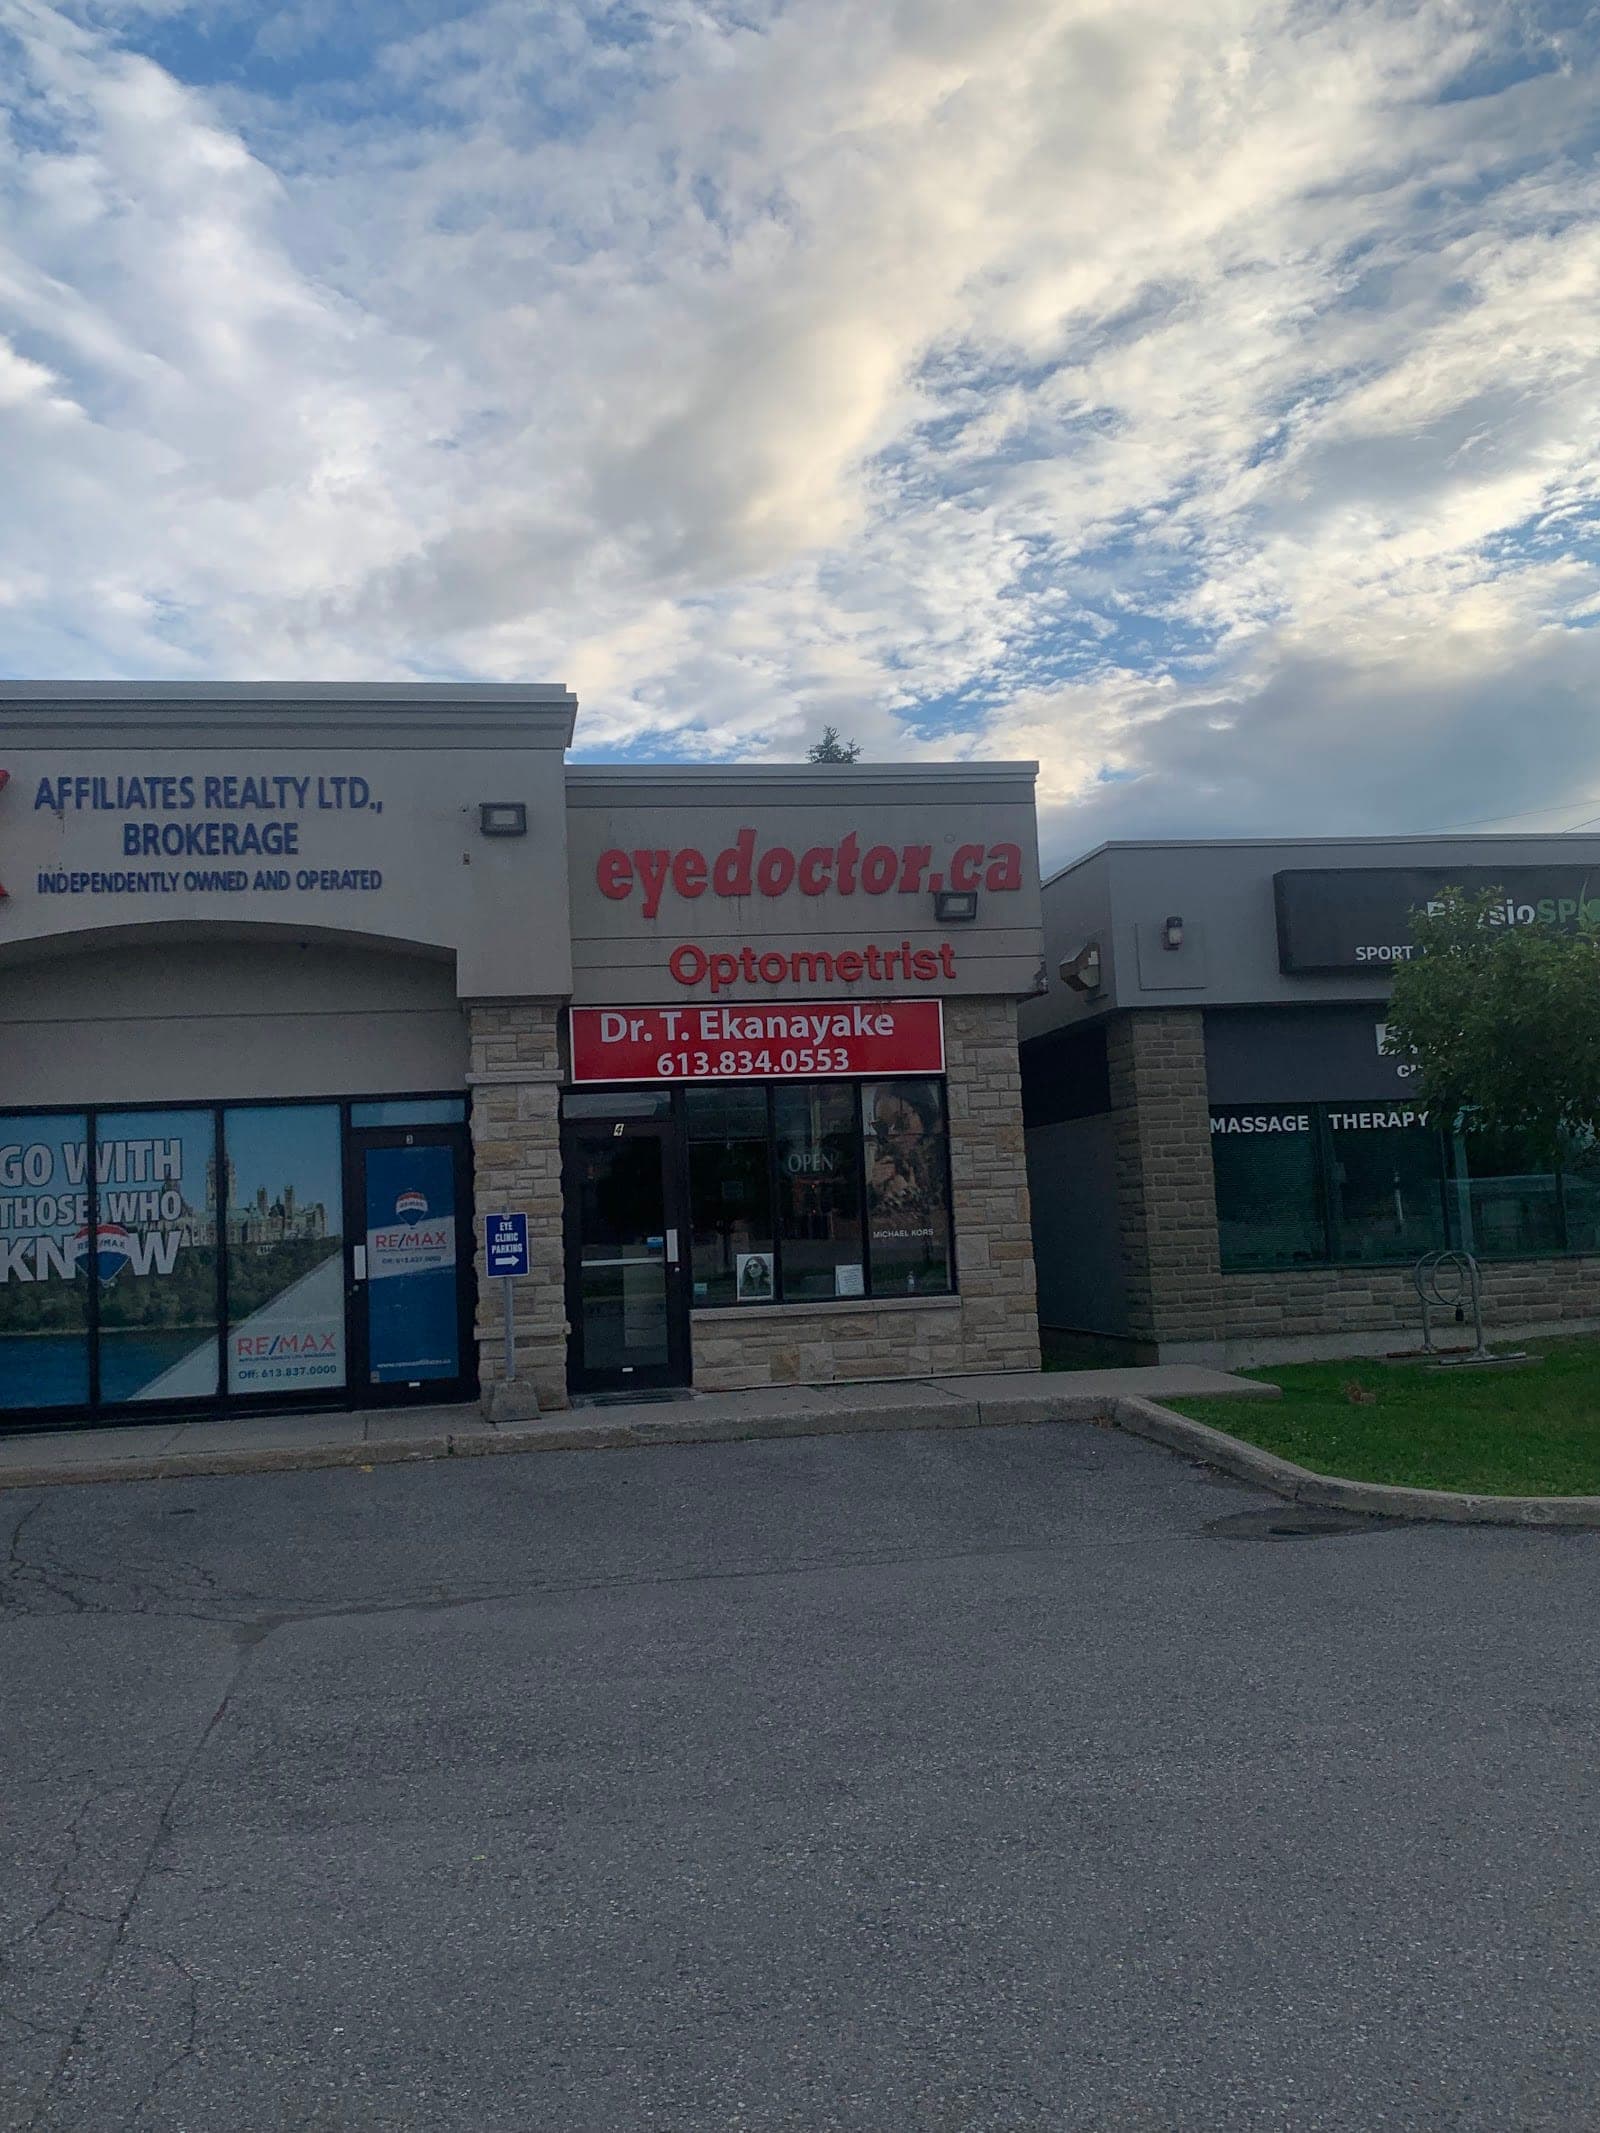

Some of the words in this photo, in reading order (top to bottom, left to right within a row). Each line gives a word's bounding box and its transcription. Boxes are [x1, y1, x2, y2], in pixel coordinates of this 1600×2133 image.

[35, 776, 196, 810] AFFILIATES
[205, 776, 309, 810] REALTY
[124, 822, 299, 856] BROKERAGE
[38, 872, 180, 893] INDEPENDENTLY
[184, 871, 248, 892] OWNED
[253, 870, 291, 891] AND
[296, 870, 382, 890] OPERATED
[596, 827, 1023, 919] eyedoctor.ca
[1355, 946, 1413, 961] SPORT
[669, 942, 957, 993] Optometrist
[600, 1013, 653, 1043] Dr.
[660, 1012, 690, 1041] T.
[700, 1007, 895, 1046] Ekanayake
[656, 1048, 850, 1077] 613.834.0553
[1210, 1115, 1309, 1133] MASSAGE
[1328, 1111, 1430, 1130] THERAPY
[0, 1143, 54, 1188] GO
[62, 1138, 183, 1185] WITH
[788, 1154, 834, 1173] OPEN
[0, 1194, 100, 1228] THOSE
[108, 1190, 182, 1223] WHO
[495, 1232, 519, 1243] CLINIC
[499, 1222, 513, 1232] EYE
[873, 1230, 909, 1239] MICHAEL
[911, 1228, 934, 1237] KORS
[376, 1232, 447, 1248] RE/MAX
[491, 1243, 523, 1255] PARKING
[237, 1333, 336, 1355] RE/MAX
